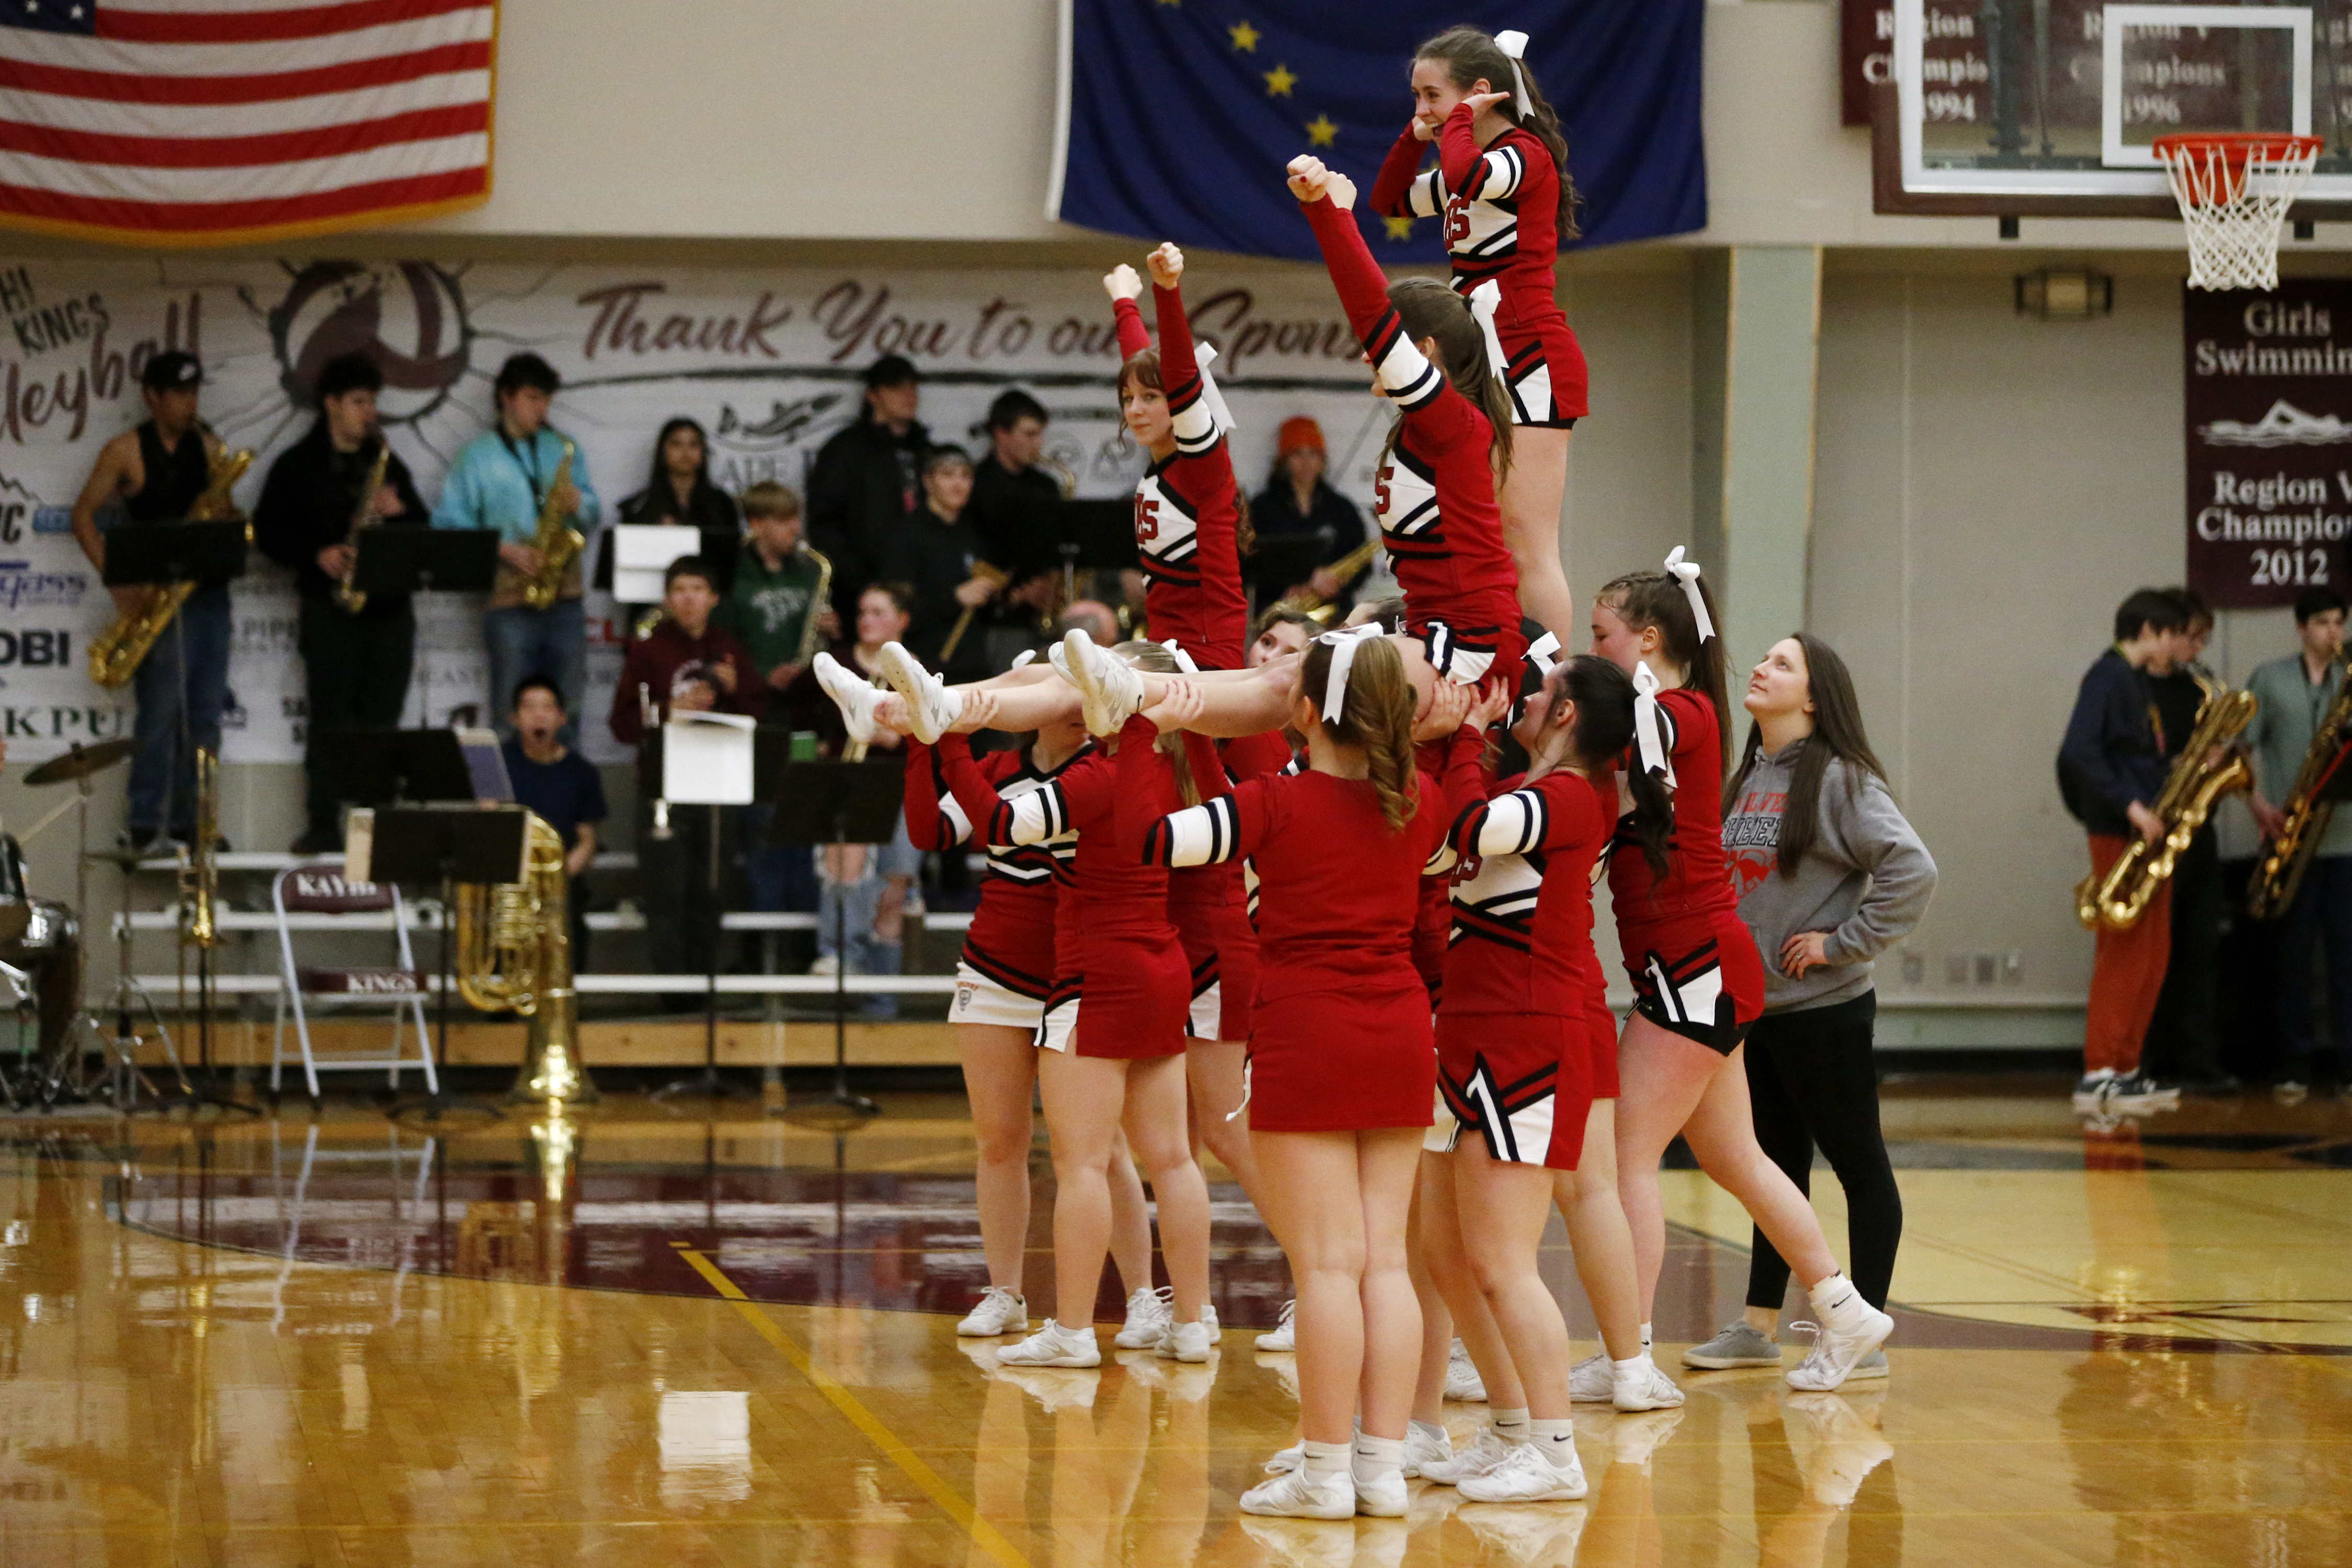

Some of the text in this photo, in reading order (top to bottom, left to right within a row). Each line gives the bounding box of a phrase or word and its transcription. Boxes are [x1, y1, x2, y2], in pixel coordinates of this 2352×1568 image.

[1875, 6, 1975, 42] Rion
[12, 291, 110, 359] KINGS
[577, 282, 793, 361] Thank
[810, 279, 951, 363] You
[967, 297, 1035, 361] to
[1047, 316, 1156, 360] ou
[2244, 299, 2331, 338] Girls
[0, 290, 203, 446] leyball
[2213, 471, 2327, 511] Region
[2250, 548, 2330, 586] 2012
[347, 973, 417, 991] KINGS
